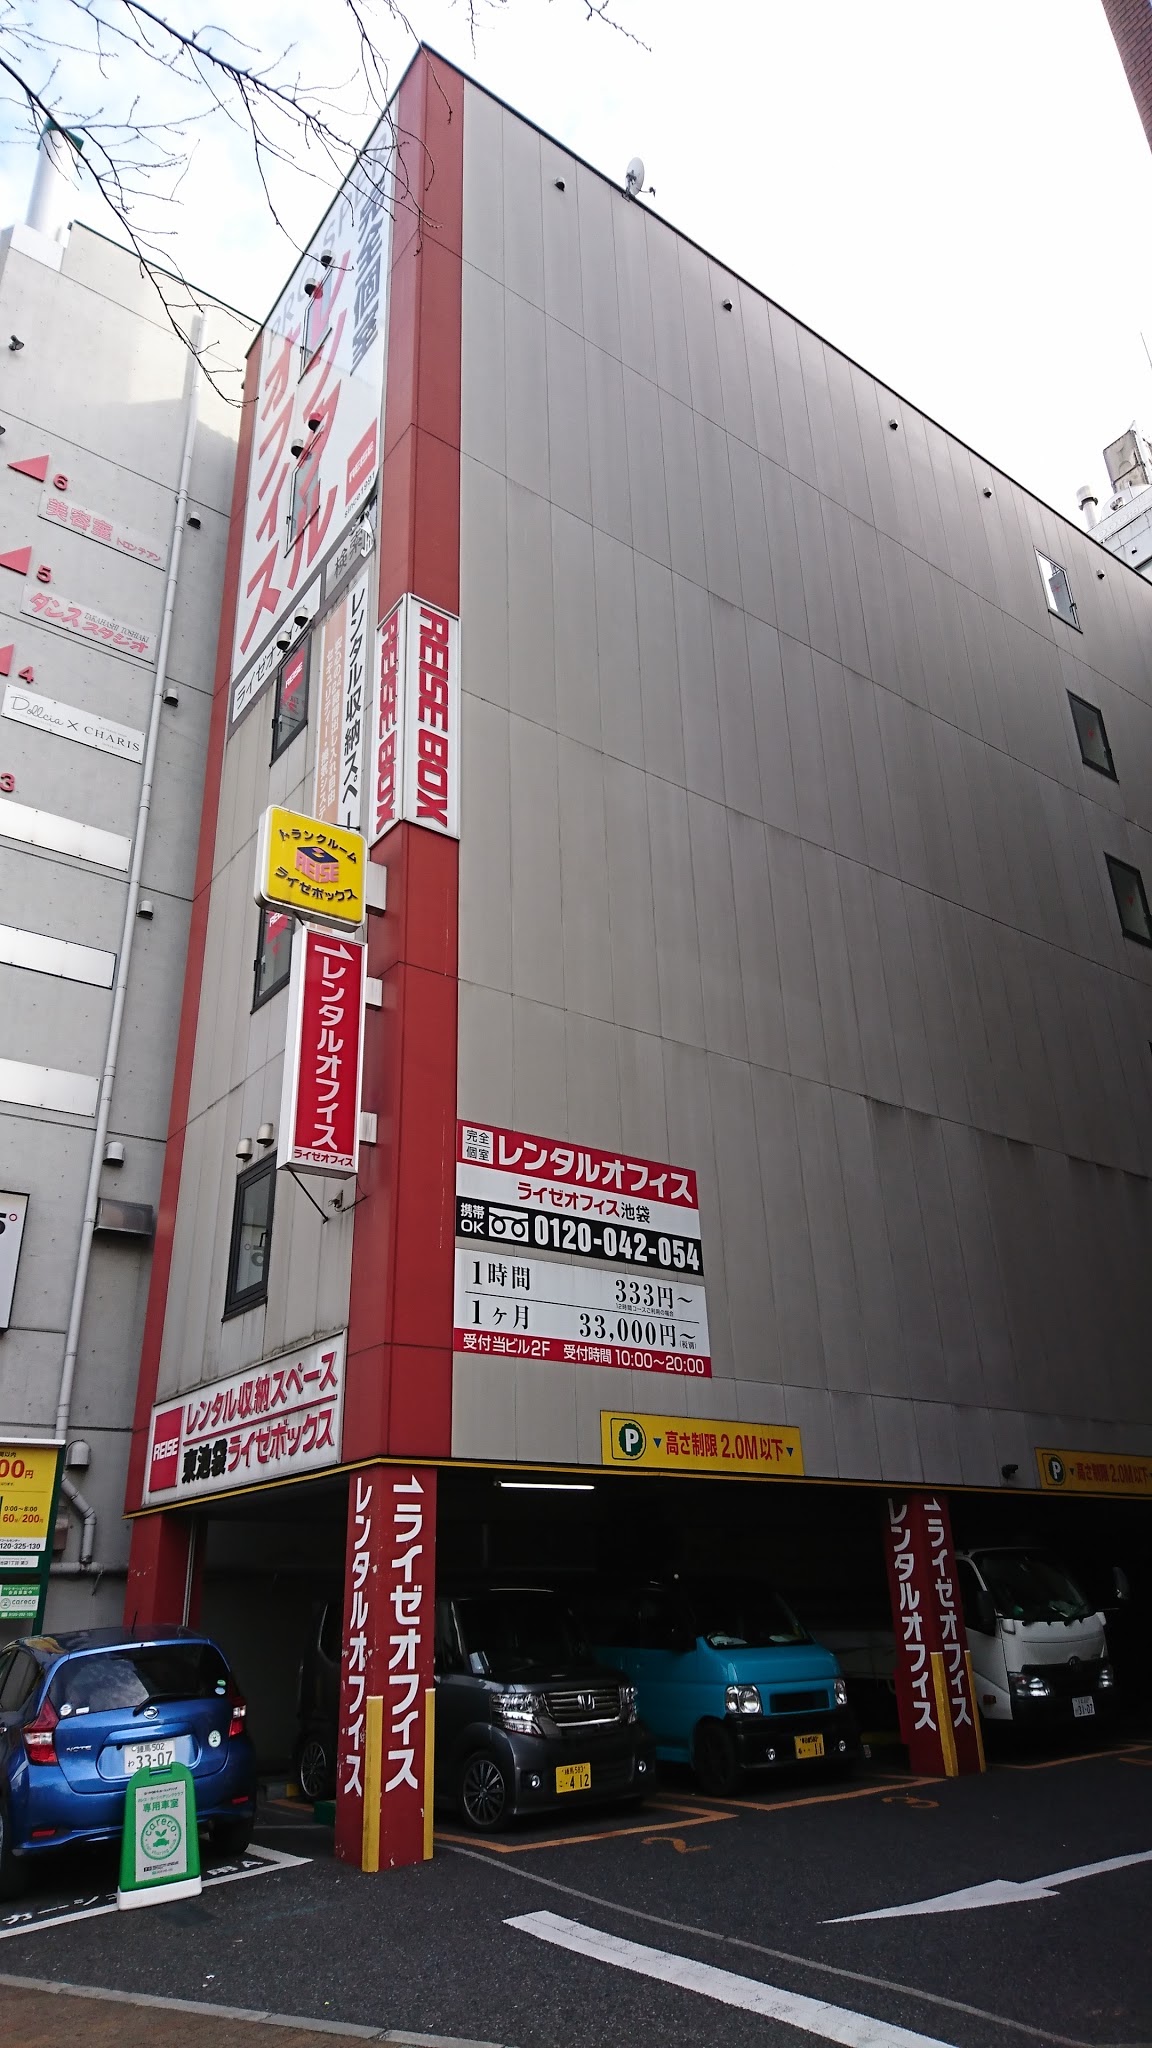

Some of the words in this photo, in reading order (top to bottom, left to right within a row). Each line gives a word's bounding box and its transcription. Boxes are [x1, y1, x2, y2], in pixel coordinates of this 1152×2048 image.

[53, 473, 68, 491] 6
[240, 322, 302, 655] オフィス
[46, 498, 113, 541] 美容室
[37, 565, 52, 584] 5
[30, 592, 82, 628] ダンス
[84, 612, 120, 632] TAKAHASHI
[121, 627, 149, 643] TOSHIAKI
[82, 621, 149, 653] スタジオ
[18, 666, 34, 684] 4
[379, 609, 400, 740] REISE
[418, 606, 449, 733] REISE
[10, 695, 64, 725] Dollcia
[84, 725, 140, 752] CHARIS
[0, 772, 15, 793] 3
[376, 729, 398, 834] BOX
[416, 728, 449, 828] BOX
[279, 828, 357, 864] トランクルーム
[274, 866, 358, 902] ライゼボックス
[295, 853, 340, 883] REISE
[311, 957, 347, 1150] レンタルオフィス
[293, 1149, 354, 1168] ライゼオフィス
[466, 1146, 490, 1162] 個室
[466, 1129, 490, 1145] 完全
[498, 1135, 694, 1204] レンタルオフィス
[517, 1181, 651, 1224] ライゼオフィス池袋
[460, 1219, 485, 1235] OK
[460, 1202, 485, 1220] 携帯
[534, 1214, 700, 1271] 0120-042-054
[472, 1260, 531, 1291] 1時間
[463, 1333, 550, 1357] 受付当ビル2F
[563, 1344, 612, 1364] 受付時間
[186, 1351, 338, 1435] レンタル収納スペース
[153, 1437, 180, 1461] REISE
[888, 1498, 937, 1731] レンタルオフィス
[927, 1519, 972, 1728] ライゼオフィス
[344, 1477, 373, 1797] レンタルオフィス
[385, 1504, 424, 1793] ライゼオフィス
[136, 1750, 173, 1769] 33-07
[151, 1742, 165, 1752] 502
[143, 1798, 179, 1812] 専用車室
[145, 1818, 177, 1837] careco
